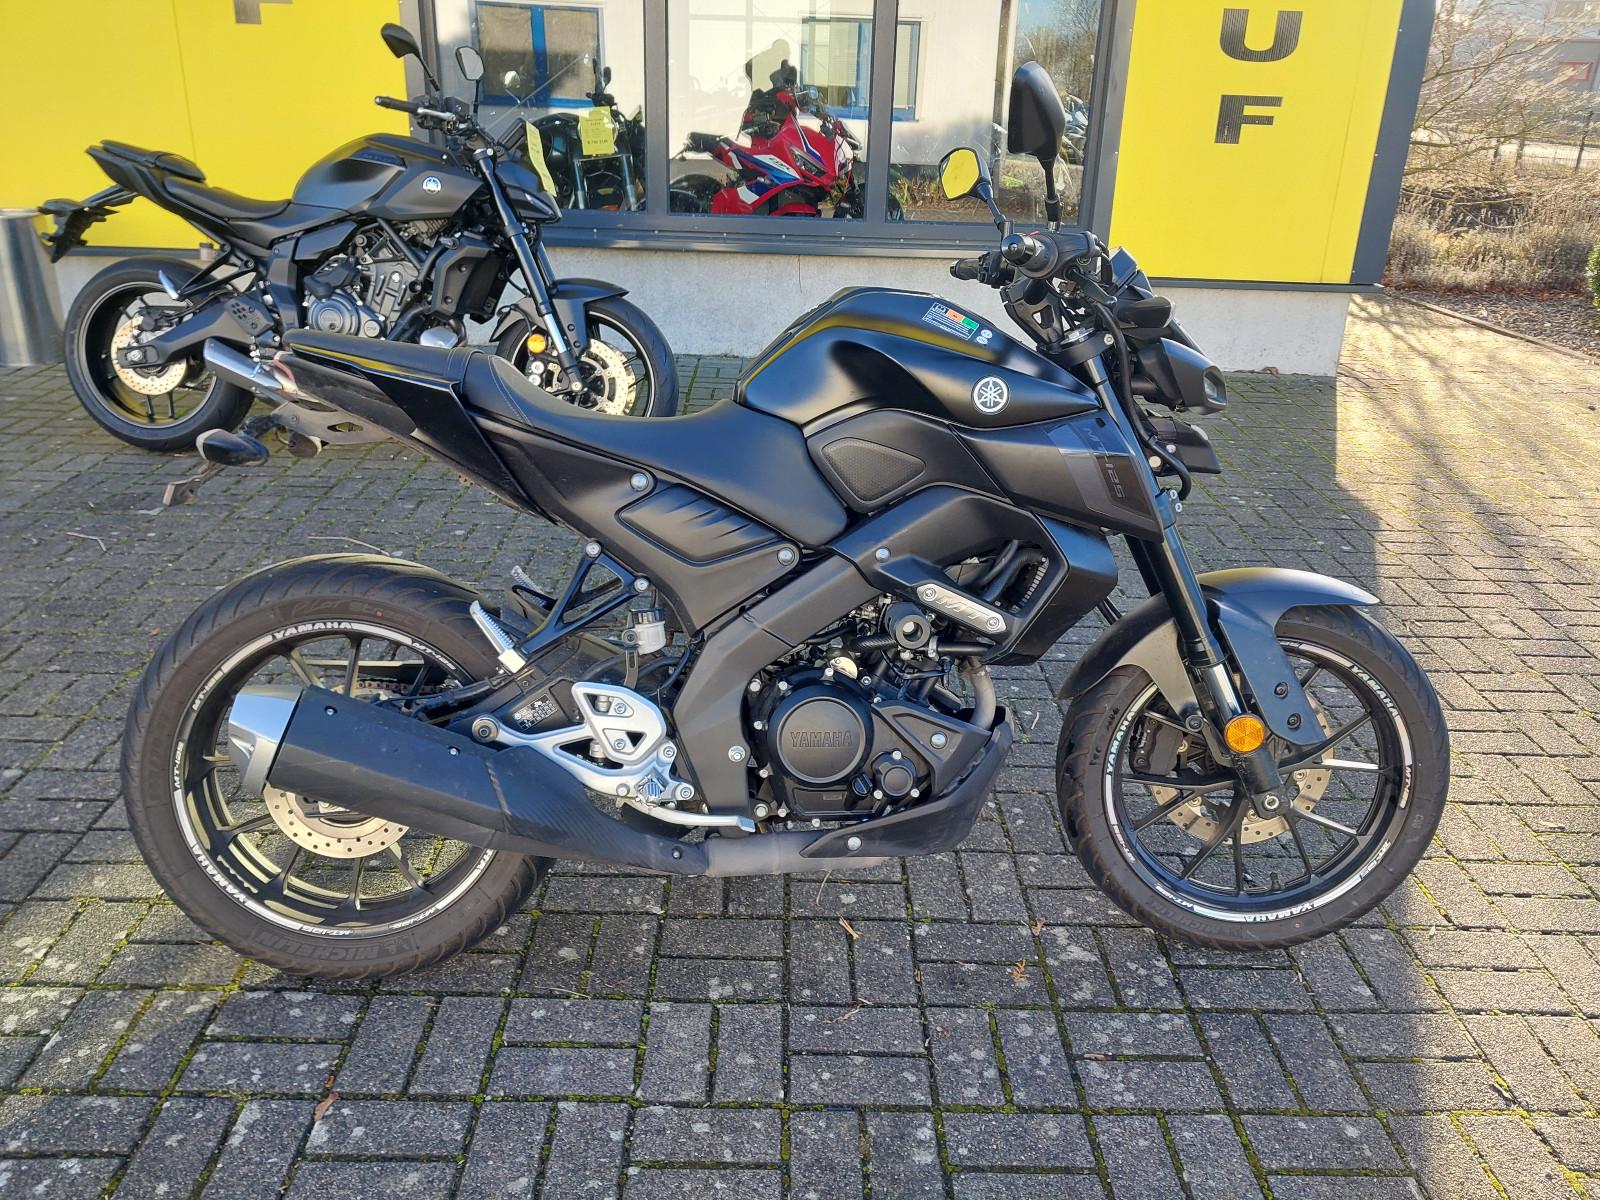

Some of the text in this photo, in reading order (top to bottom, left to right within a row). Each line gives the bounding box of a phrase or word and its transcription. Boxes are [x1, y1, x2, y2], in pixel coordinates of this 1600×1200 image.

[272, 622, 352, 640] YAMAHA
[412, 641, 456, 670] MT-125
[1351, 665, 1399, 717] YAMAHA
[790, 730, 852, 748] YAMAHA
[1107, 711, 1136, 774] YAMAHA
[174, 741, 184, 788] MT-125
[192, 846, 246, 902] YAMAHA
[1246, 902, 1315, 922] YAMAHA
[256, 931, 380, 960] MICHELIN
